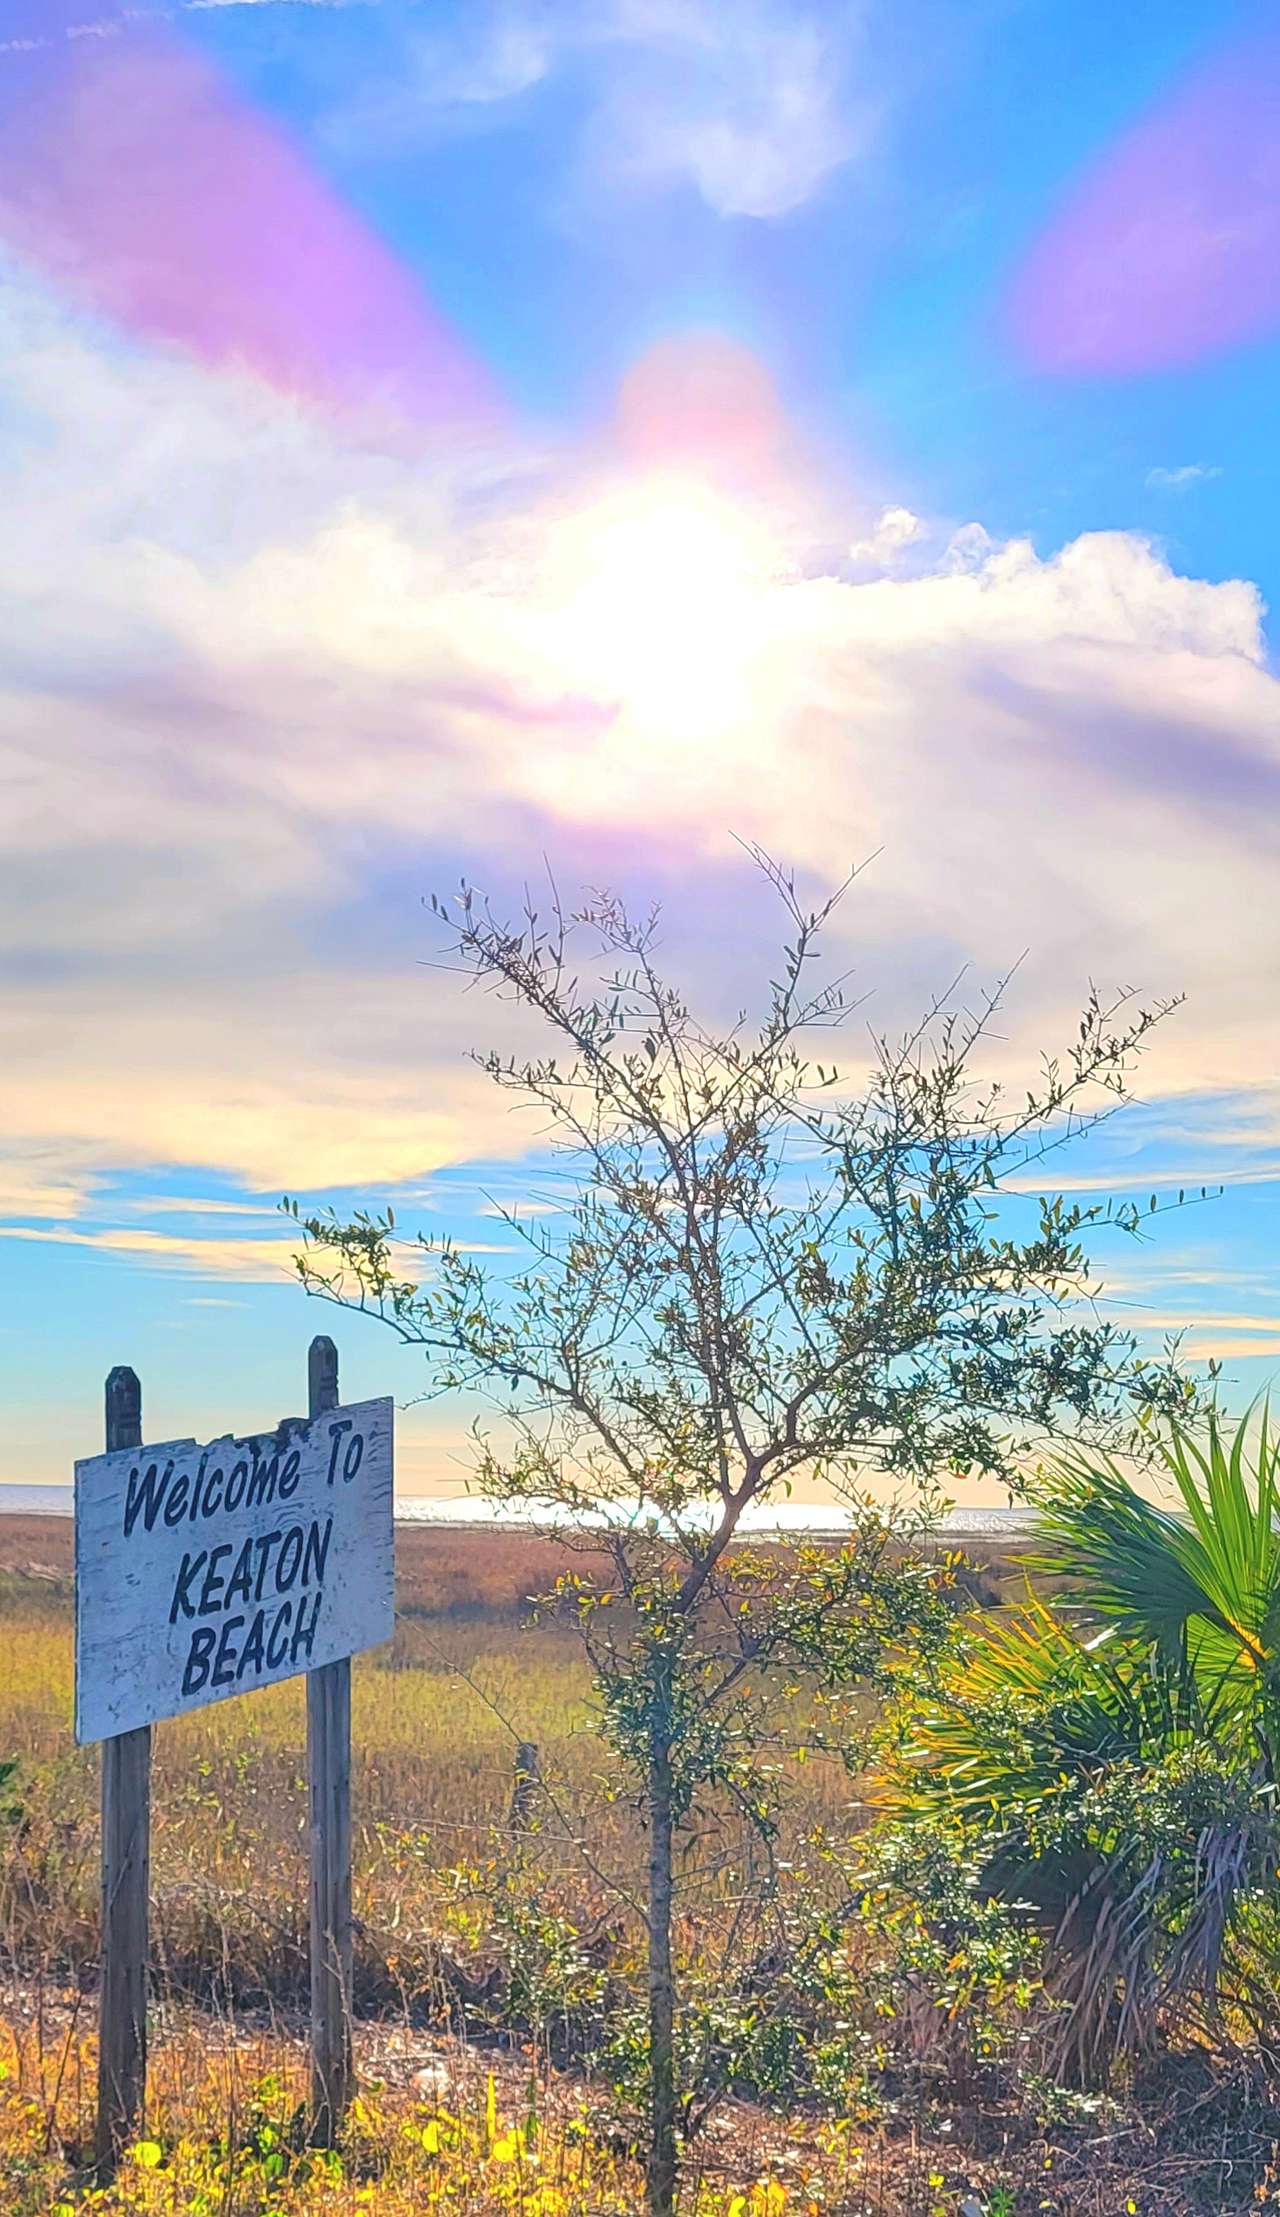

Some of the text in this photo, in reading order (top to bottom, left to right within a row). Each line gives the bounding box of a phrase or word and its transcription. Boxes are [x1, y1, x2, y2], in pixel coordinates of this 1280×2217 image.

[123, 1420, 364, 1537] Welcome To
[169, 1518, 333, 1624] KEATON
[181, 1591, 322, 1696] BEACH
